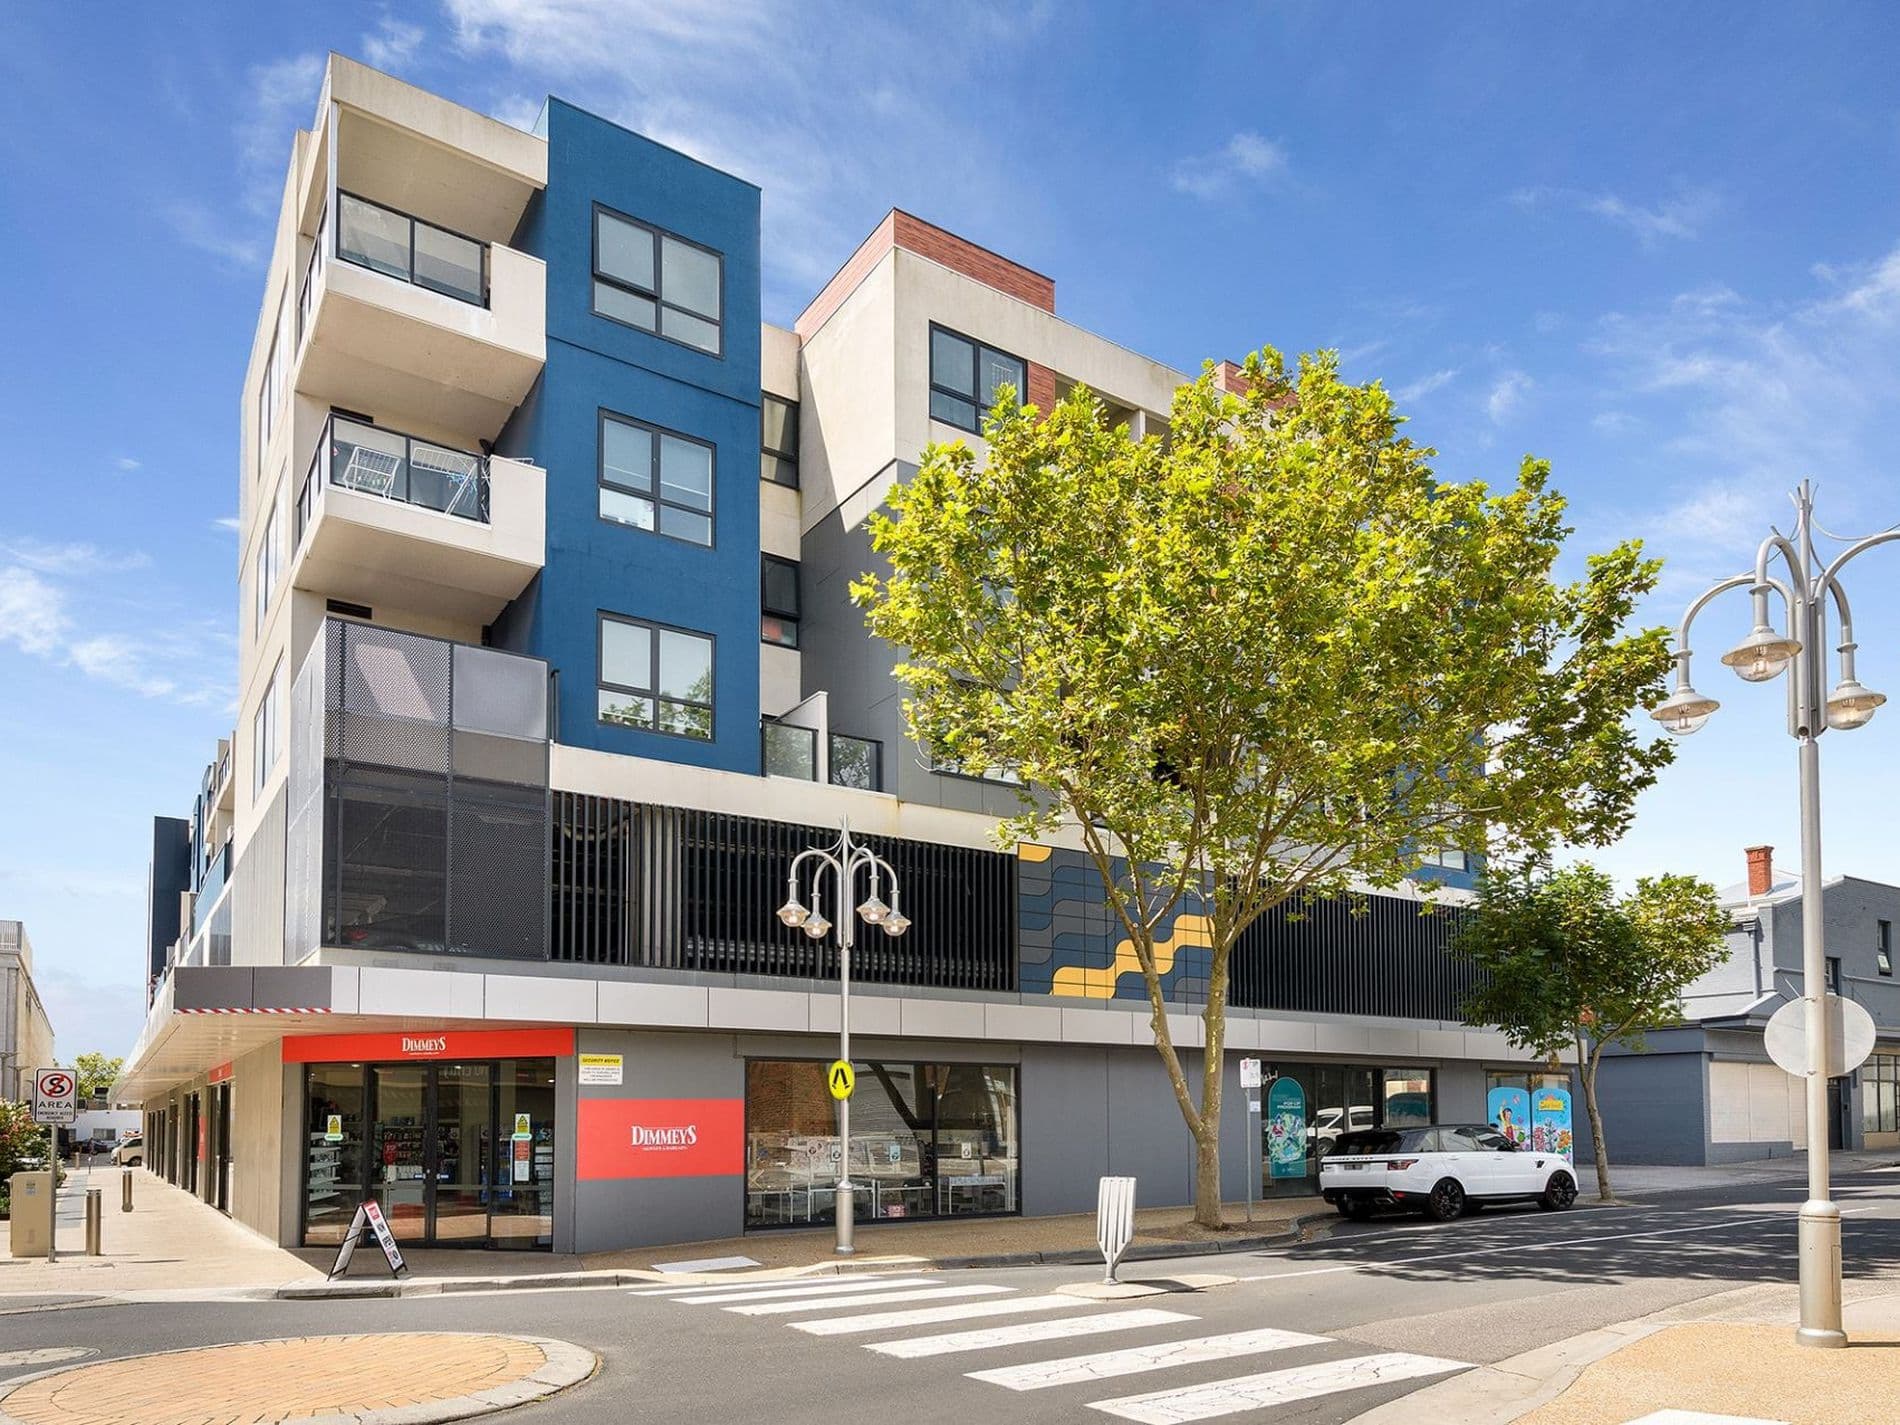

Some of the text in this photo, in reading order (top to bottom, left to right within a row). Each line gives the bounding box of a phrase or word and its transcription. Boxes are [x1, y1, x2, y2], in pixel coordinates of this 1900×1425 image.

[402, 1036, 446, 1051] DIMMEYS
[38, 1100, 73, 1109] AREA
[631, 1125, 697, 1146] DIMMEYS
